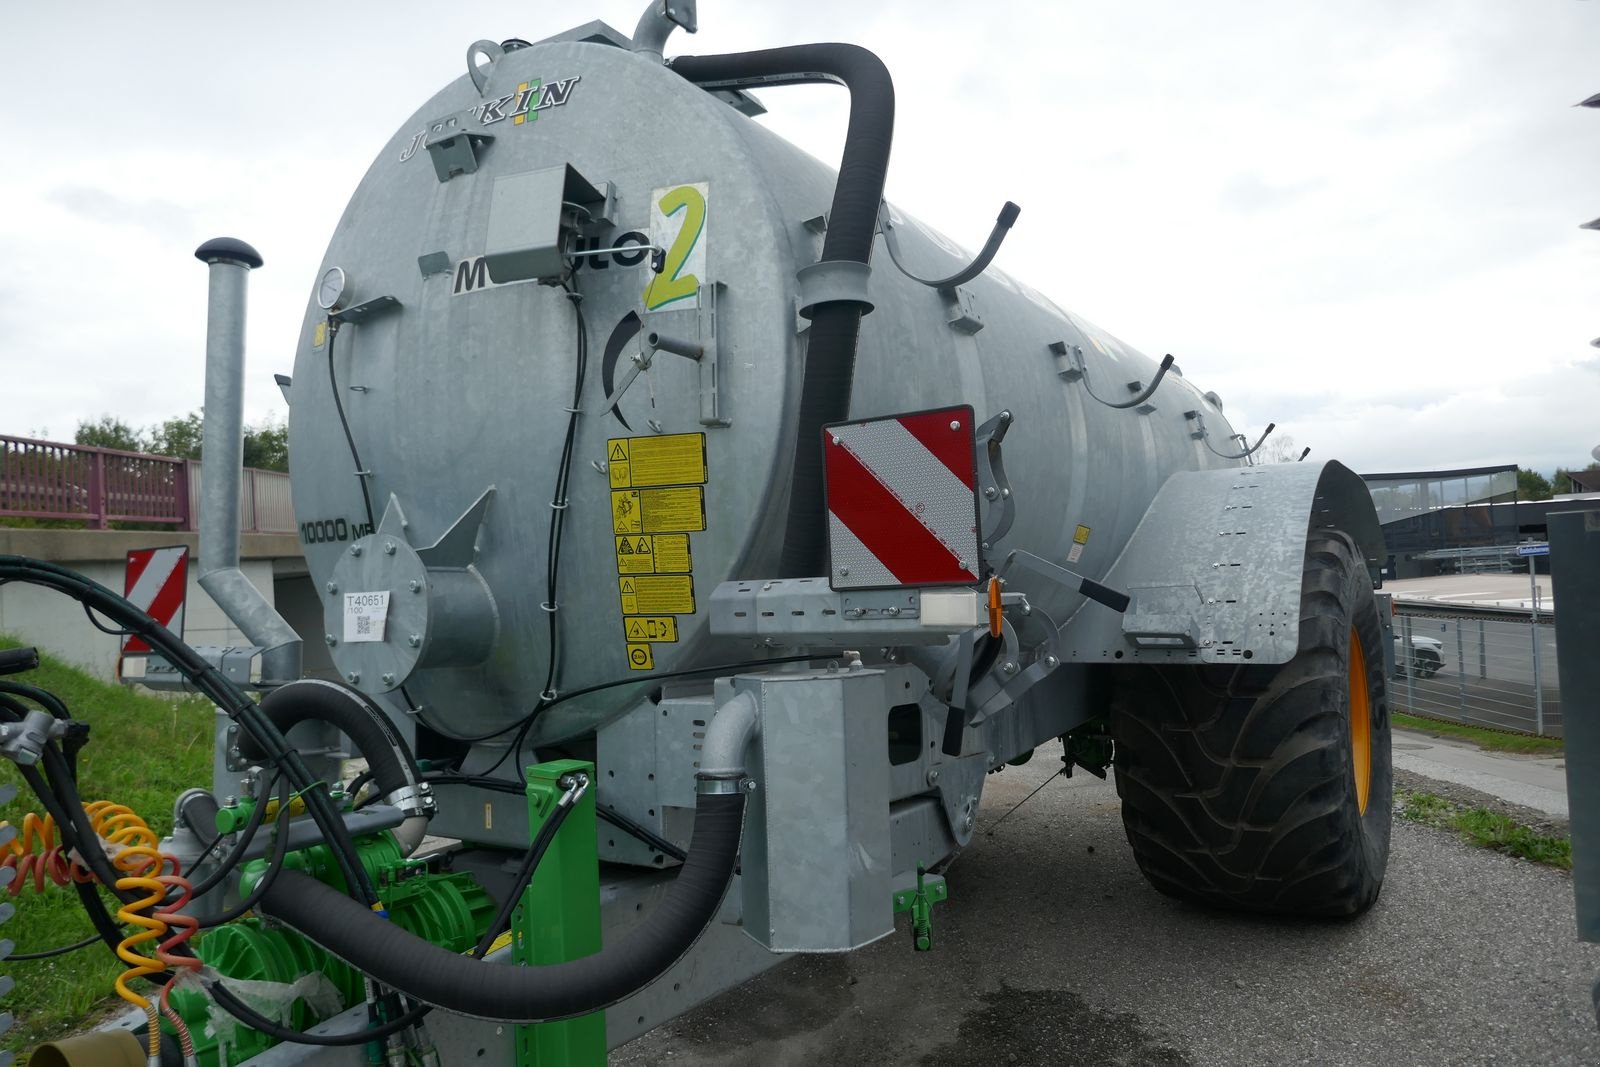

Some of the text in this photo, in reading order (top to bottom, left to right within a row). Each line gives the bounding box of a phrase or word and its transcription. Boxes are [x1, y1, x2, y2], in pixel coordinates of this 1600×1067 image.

[400, 76, 581, 162] JKIN
[642, 185, 706, 311] 2
[301, 518, 348, 544] 10000
[346, 595, 384, 606] T40651
